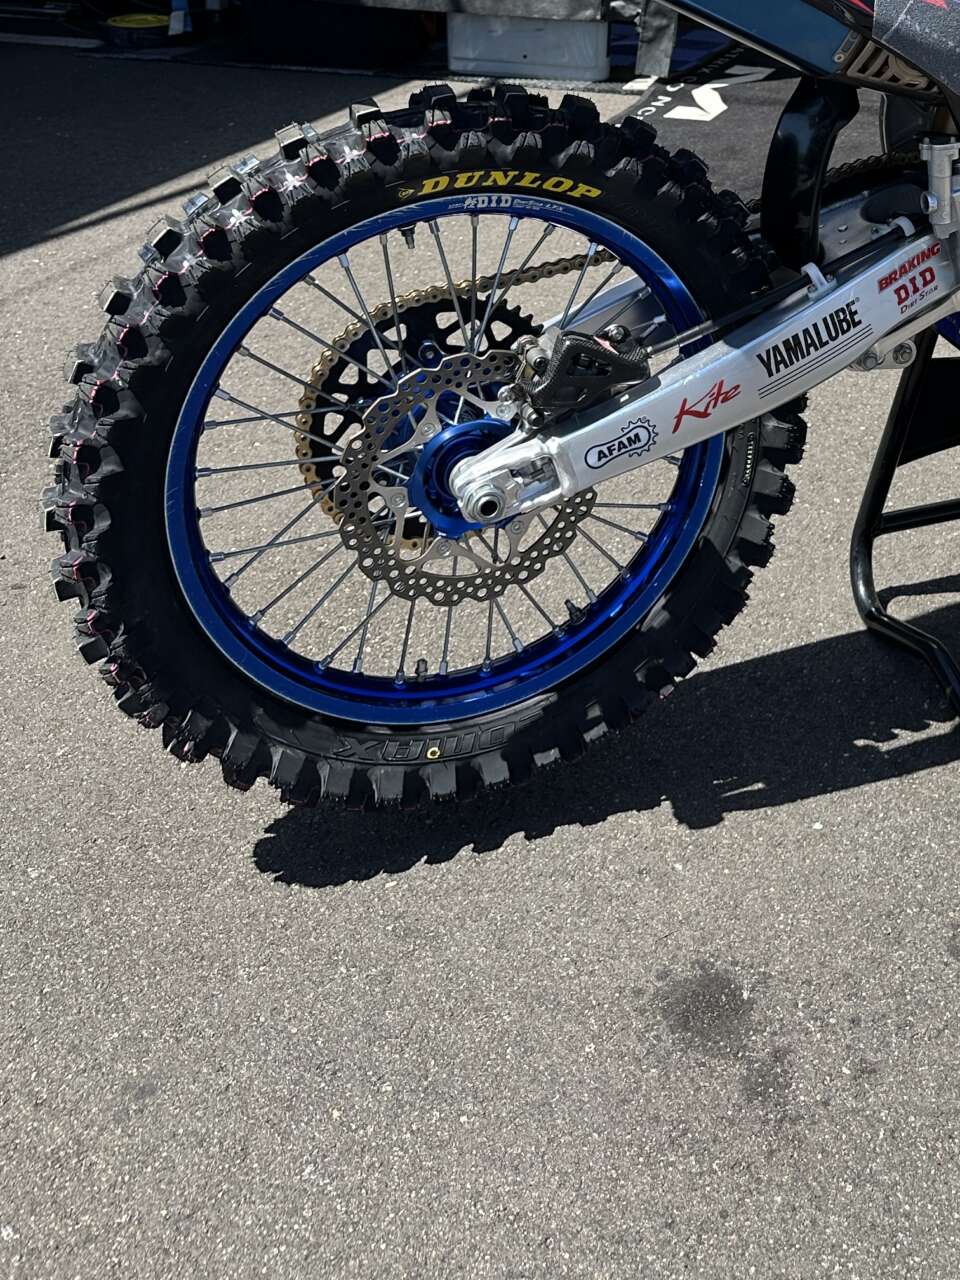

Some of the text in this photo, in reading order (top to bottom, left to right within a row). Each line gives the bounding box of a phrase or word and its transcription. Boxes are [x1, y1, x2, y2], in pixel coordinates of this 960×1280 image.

[417, 170, 602, 199] DUNLOP
[876, 242, 942, 294] BRAKING
[756, 299, 862, 378] YAMALUBE
[672, 379, 741, 434] Kite
[596, 431, 642, 463] AFAM
